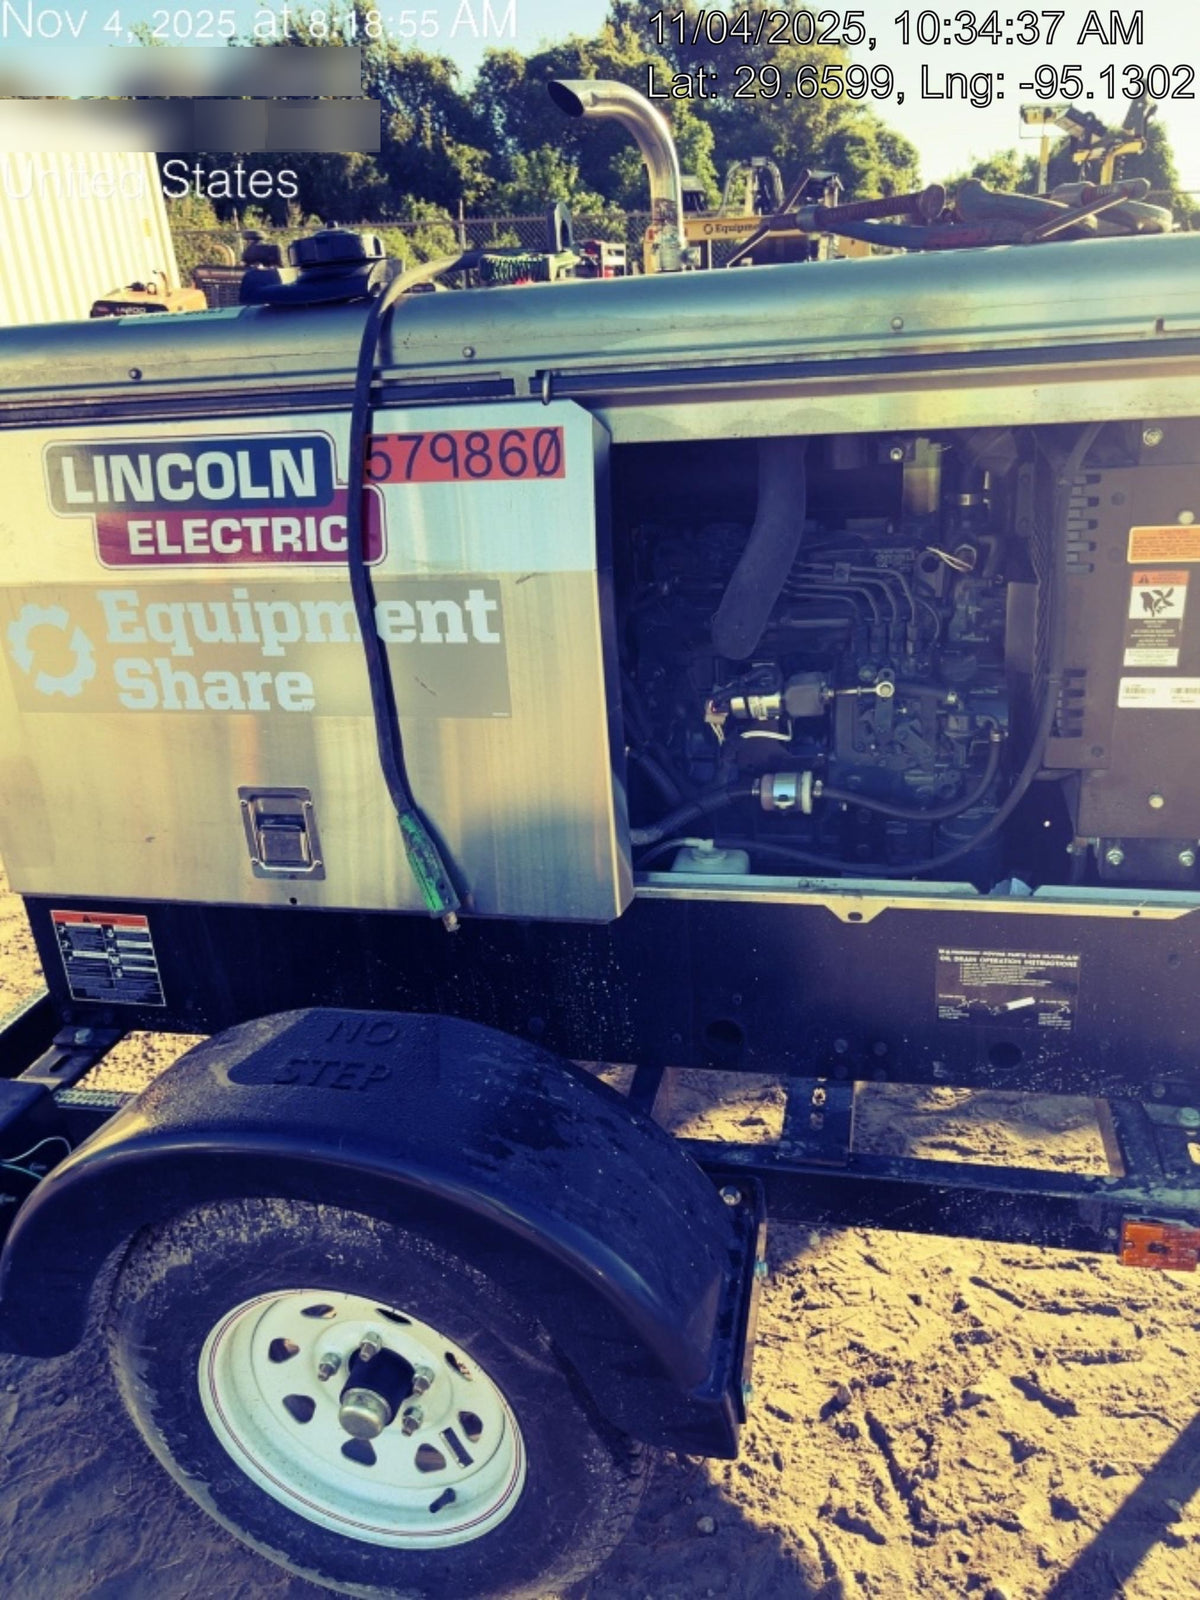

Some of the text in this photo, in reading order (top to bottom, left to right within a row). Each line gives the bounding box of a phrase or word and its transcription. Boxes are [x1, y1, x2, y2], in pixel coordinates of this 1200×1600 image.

[60, 447, 317, 504] LINCOLN
[366, 427, 562, 482] 579860
[127, 515, 349, 555] ELECTRIC
[96, 588, 501, 656] Equipment
[113, 656, 316, 712] Share
[325, 1019, 400, 1047] NO
[272, 1058, 392, 1092] STEP
